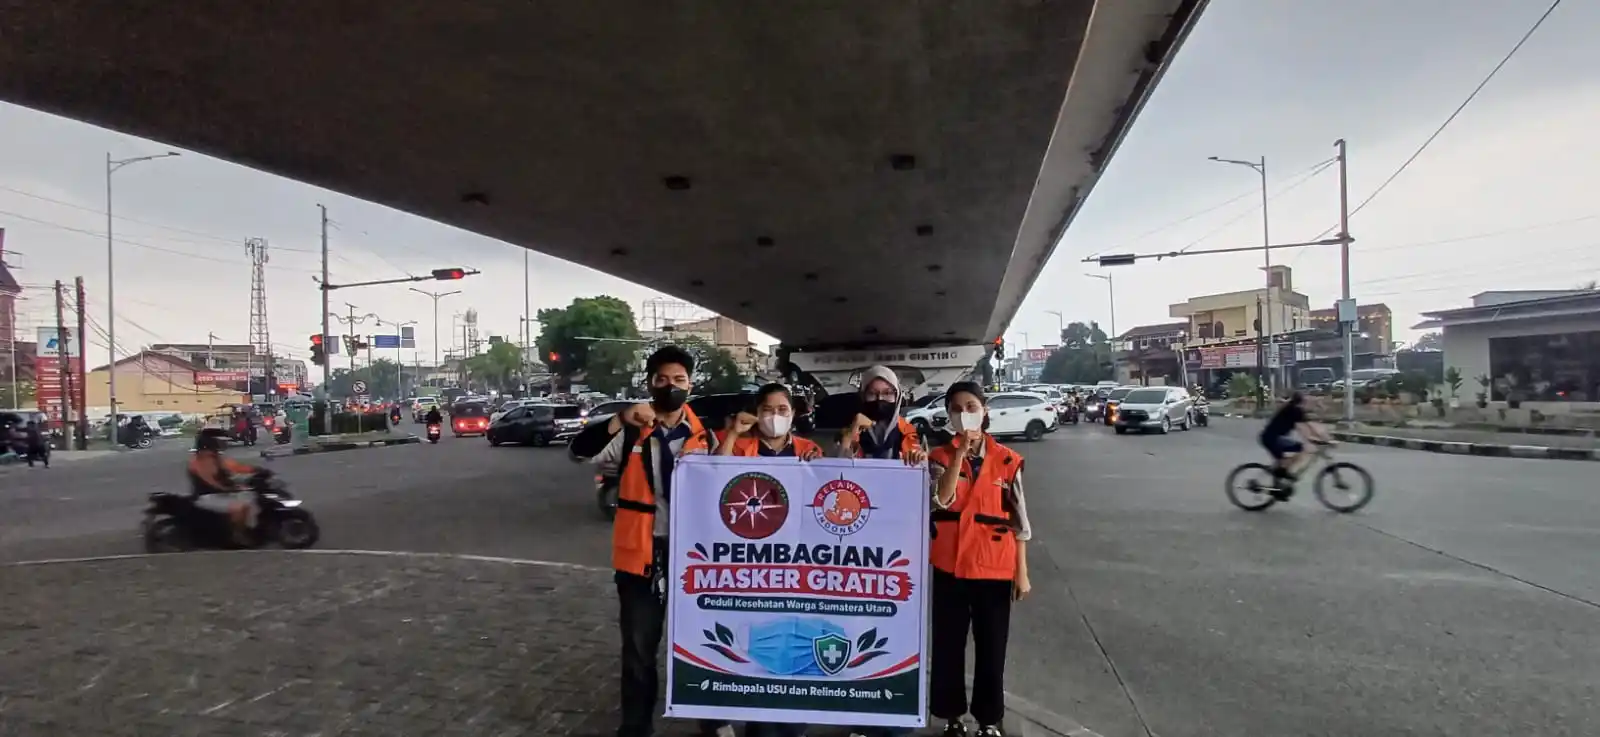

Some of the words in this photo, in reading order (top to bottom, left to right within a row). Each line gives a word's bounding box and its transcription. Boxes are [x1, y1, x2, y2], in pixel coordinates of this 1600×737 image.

[817, 482, 867, 503] RELAWAN
[817, 513, 867, 533] INDONESIA
[713, 542, 883, 567] PEMBAGIAN
[694, 568, 800, 589] MASKER
[807, 571, 900, 597] GRATIS
[704, 597, 733, 607] Peduli
[735, 598, 784, 609] Kesehatan
[786, 600, 816, 611] Warga
[818, 602, 863, 612] Sumatera
[866, 603, 892, 613] Utara
[712, 681, 765, 694] Rimbapala
[767, 683, 787, 694] USU
[789, 685, 807, 696] dan
[810, 686, 847, 697] Relindo
[849, 688, 881, 699] Sumut
